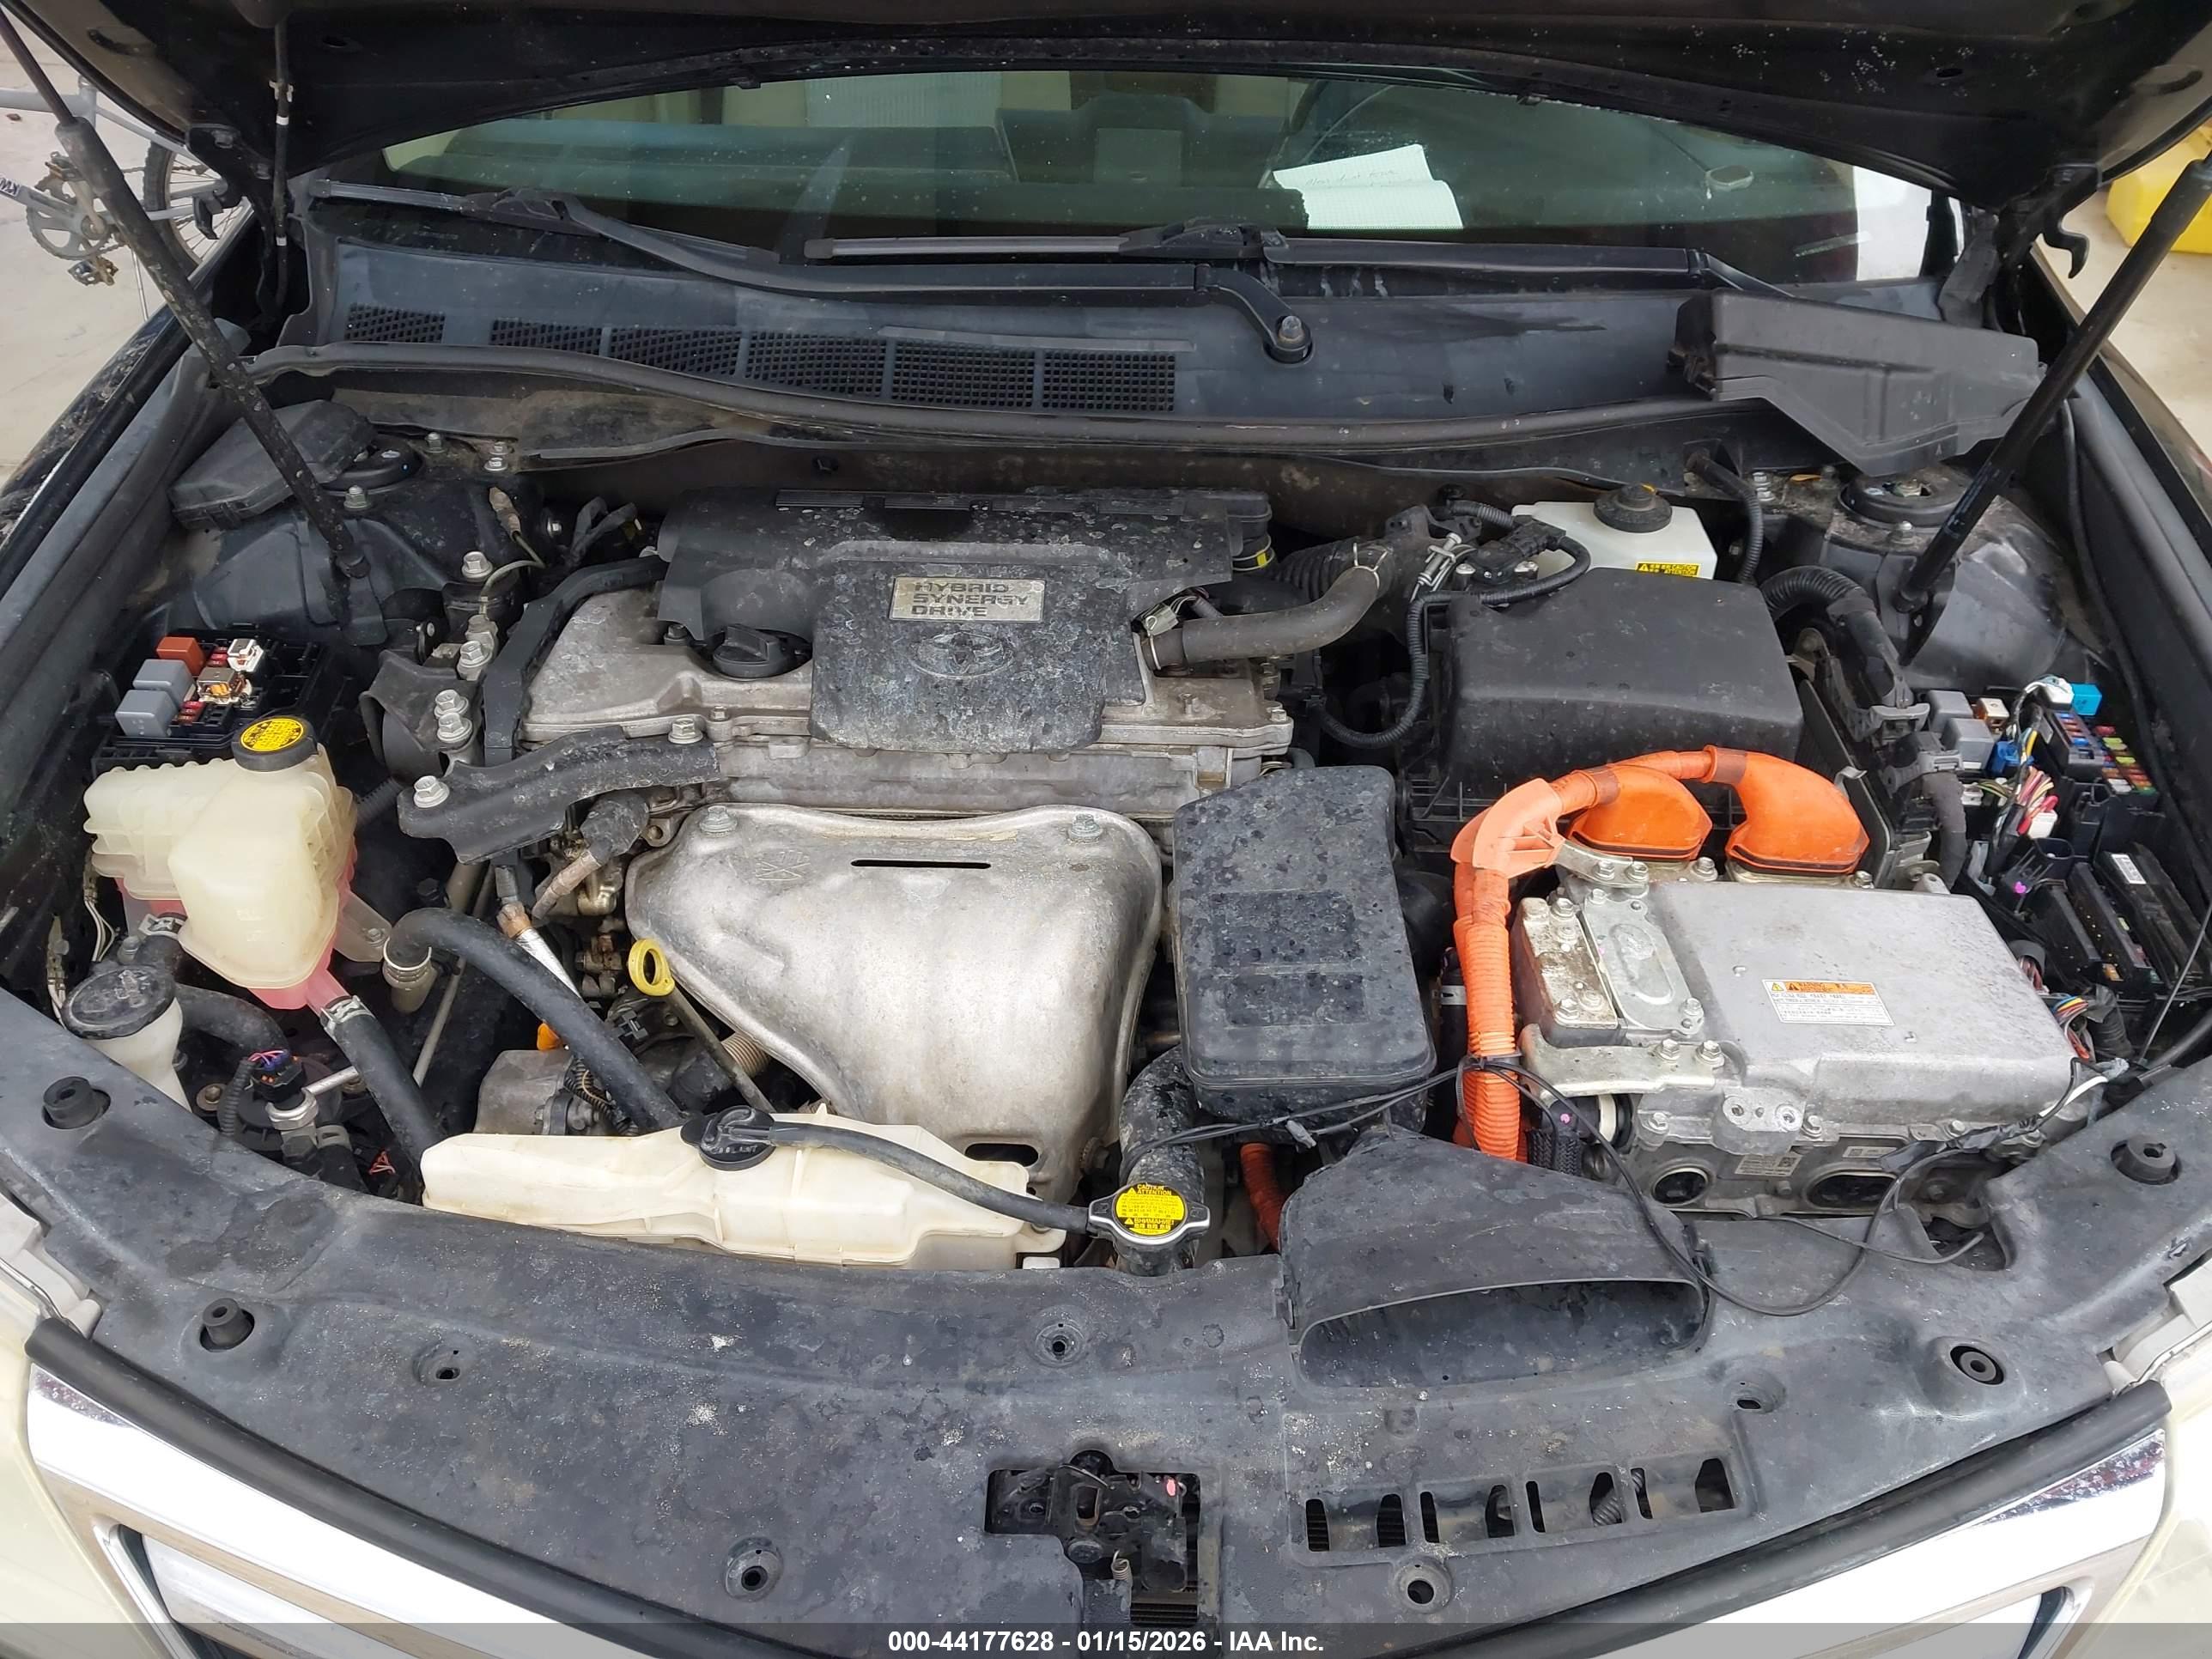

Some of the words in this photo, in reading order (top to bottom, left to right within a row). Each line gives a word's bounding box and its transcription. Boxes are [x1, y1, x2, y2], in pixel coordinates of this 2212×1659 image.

[915, 583, 1010, 593] HYBRID
[913, 593, 1030, 605] SYNERGY
[910, 605, 988, 617] DRIVE
